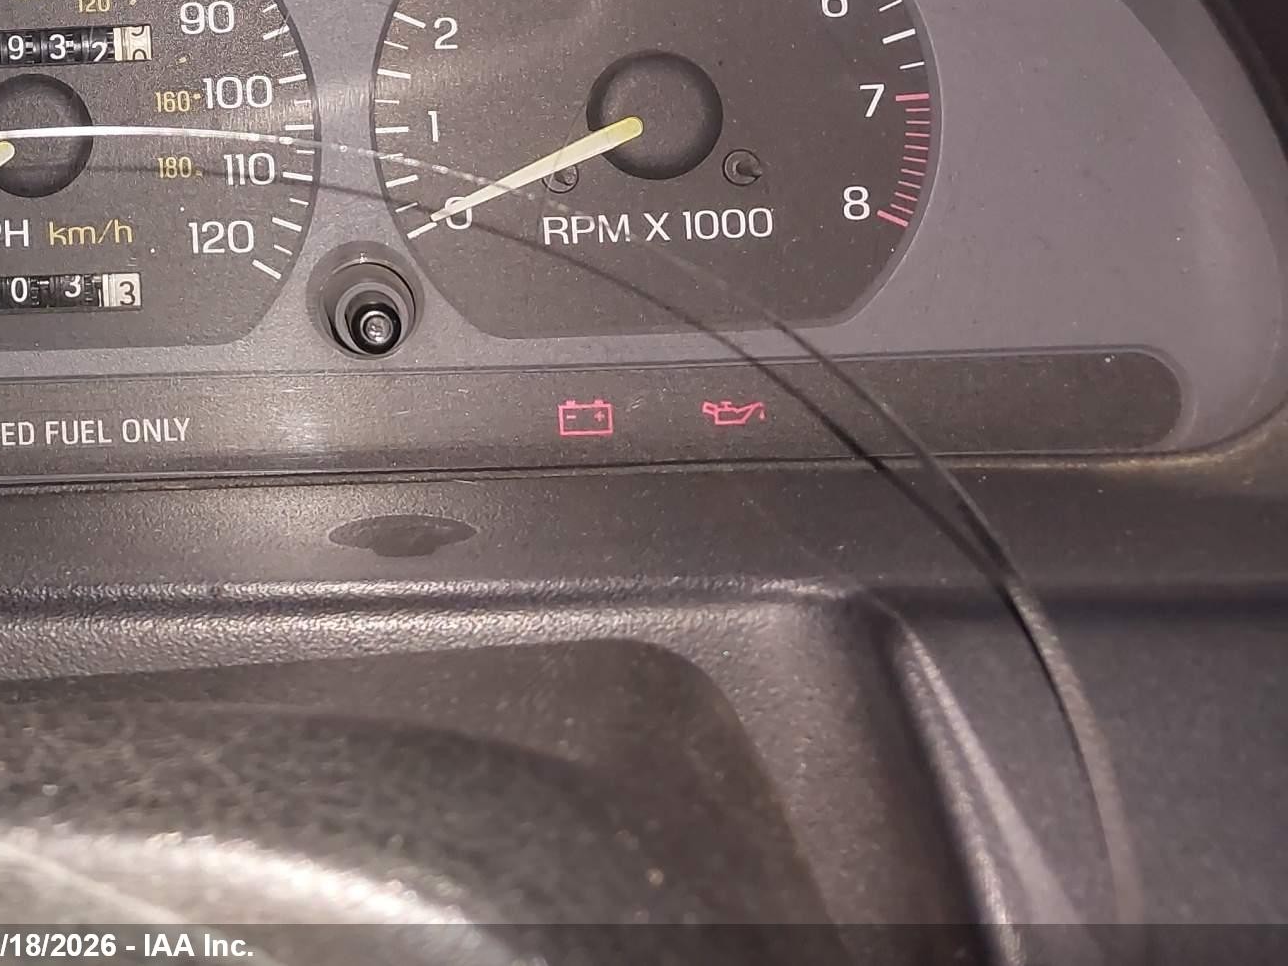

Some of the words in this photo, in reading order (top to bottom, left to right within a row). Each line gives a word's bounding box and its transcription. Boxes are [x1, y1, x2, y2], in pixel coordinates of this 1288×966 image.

[180, 1, 235, 34] 90
[433, 18, 458, 49] 2
[155, 91, 191, 113] 160
[203, 75, 273, 109] 100
[860, 84, 885, 118] 7
[427, 111, 439, 142] 1
[158, 157, 193, 179] 180
[223, 152, 276, 186] 110
[444, 196, 473, 230] 0
[843, 186, 870, 219] 8
[49, 219, 133, 246] km/h
[188, 220, 255, 254] 120
[543, 214, 631, 245] RPM
[646, 212, 671, 242] X
[683, 208, 774, 240] 1000
[46, 419, 112, 445] FUEL
[122, 417, 191, 443] ONLY
